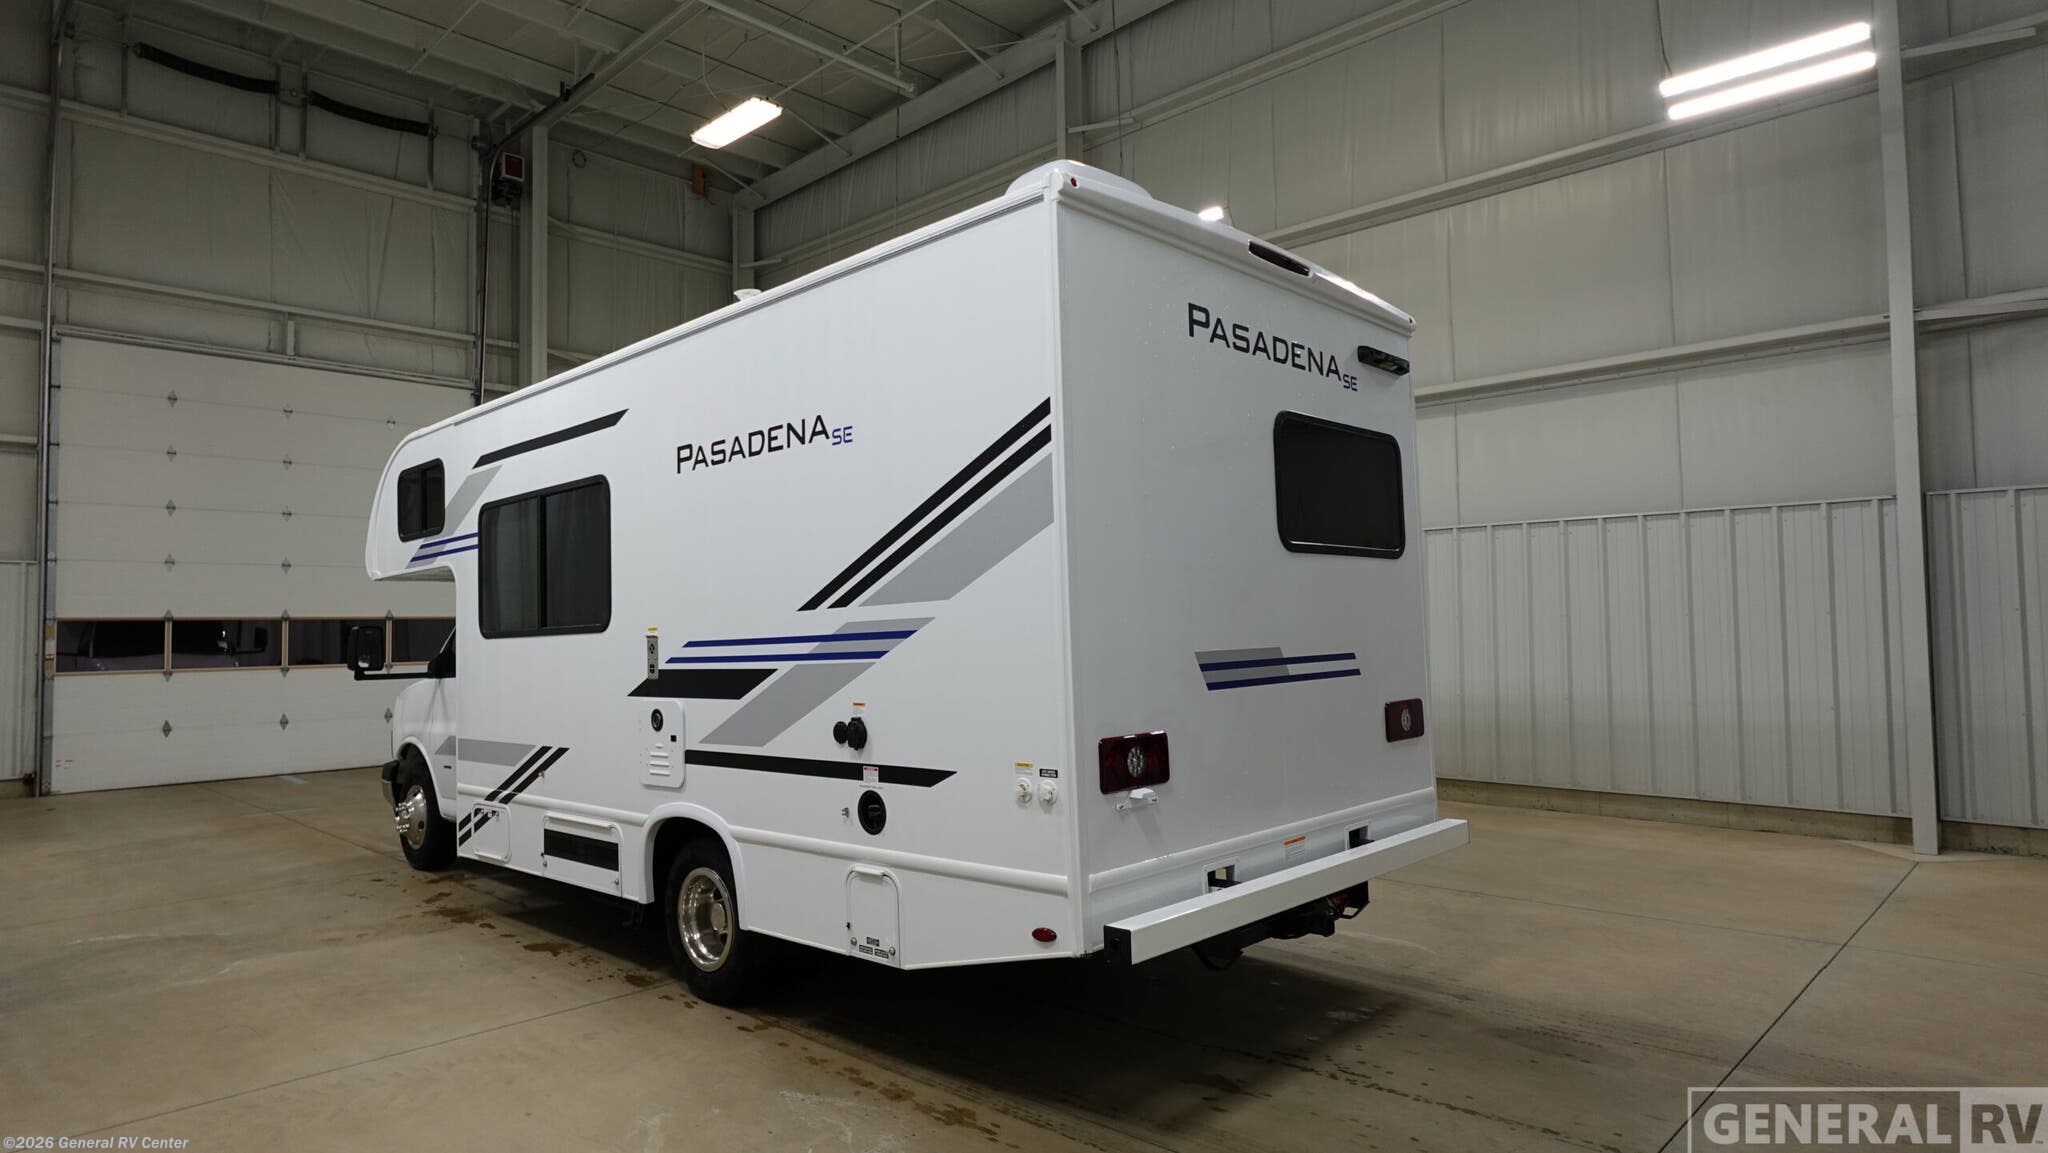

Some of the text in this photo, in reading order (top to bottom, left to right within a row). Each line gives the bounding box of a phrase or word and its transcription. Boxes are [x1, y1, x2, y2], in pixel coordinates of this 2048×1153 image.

[1188, 303, 1358, 392] PASADENA SE
[677, 414, 853, 474] PASADENA SE
